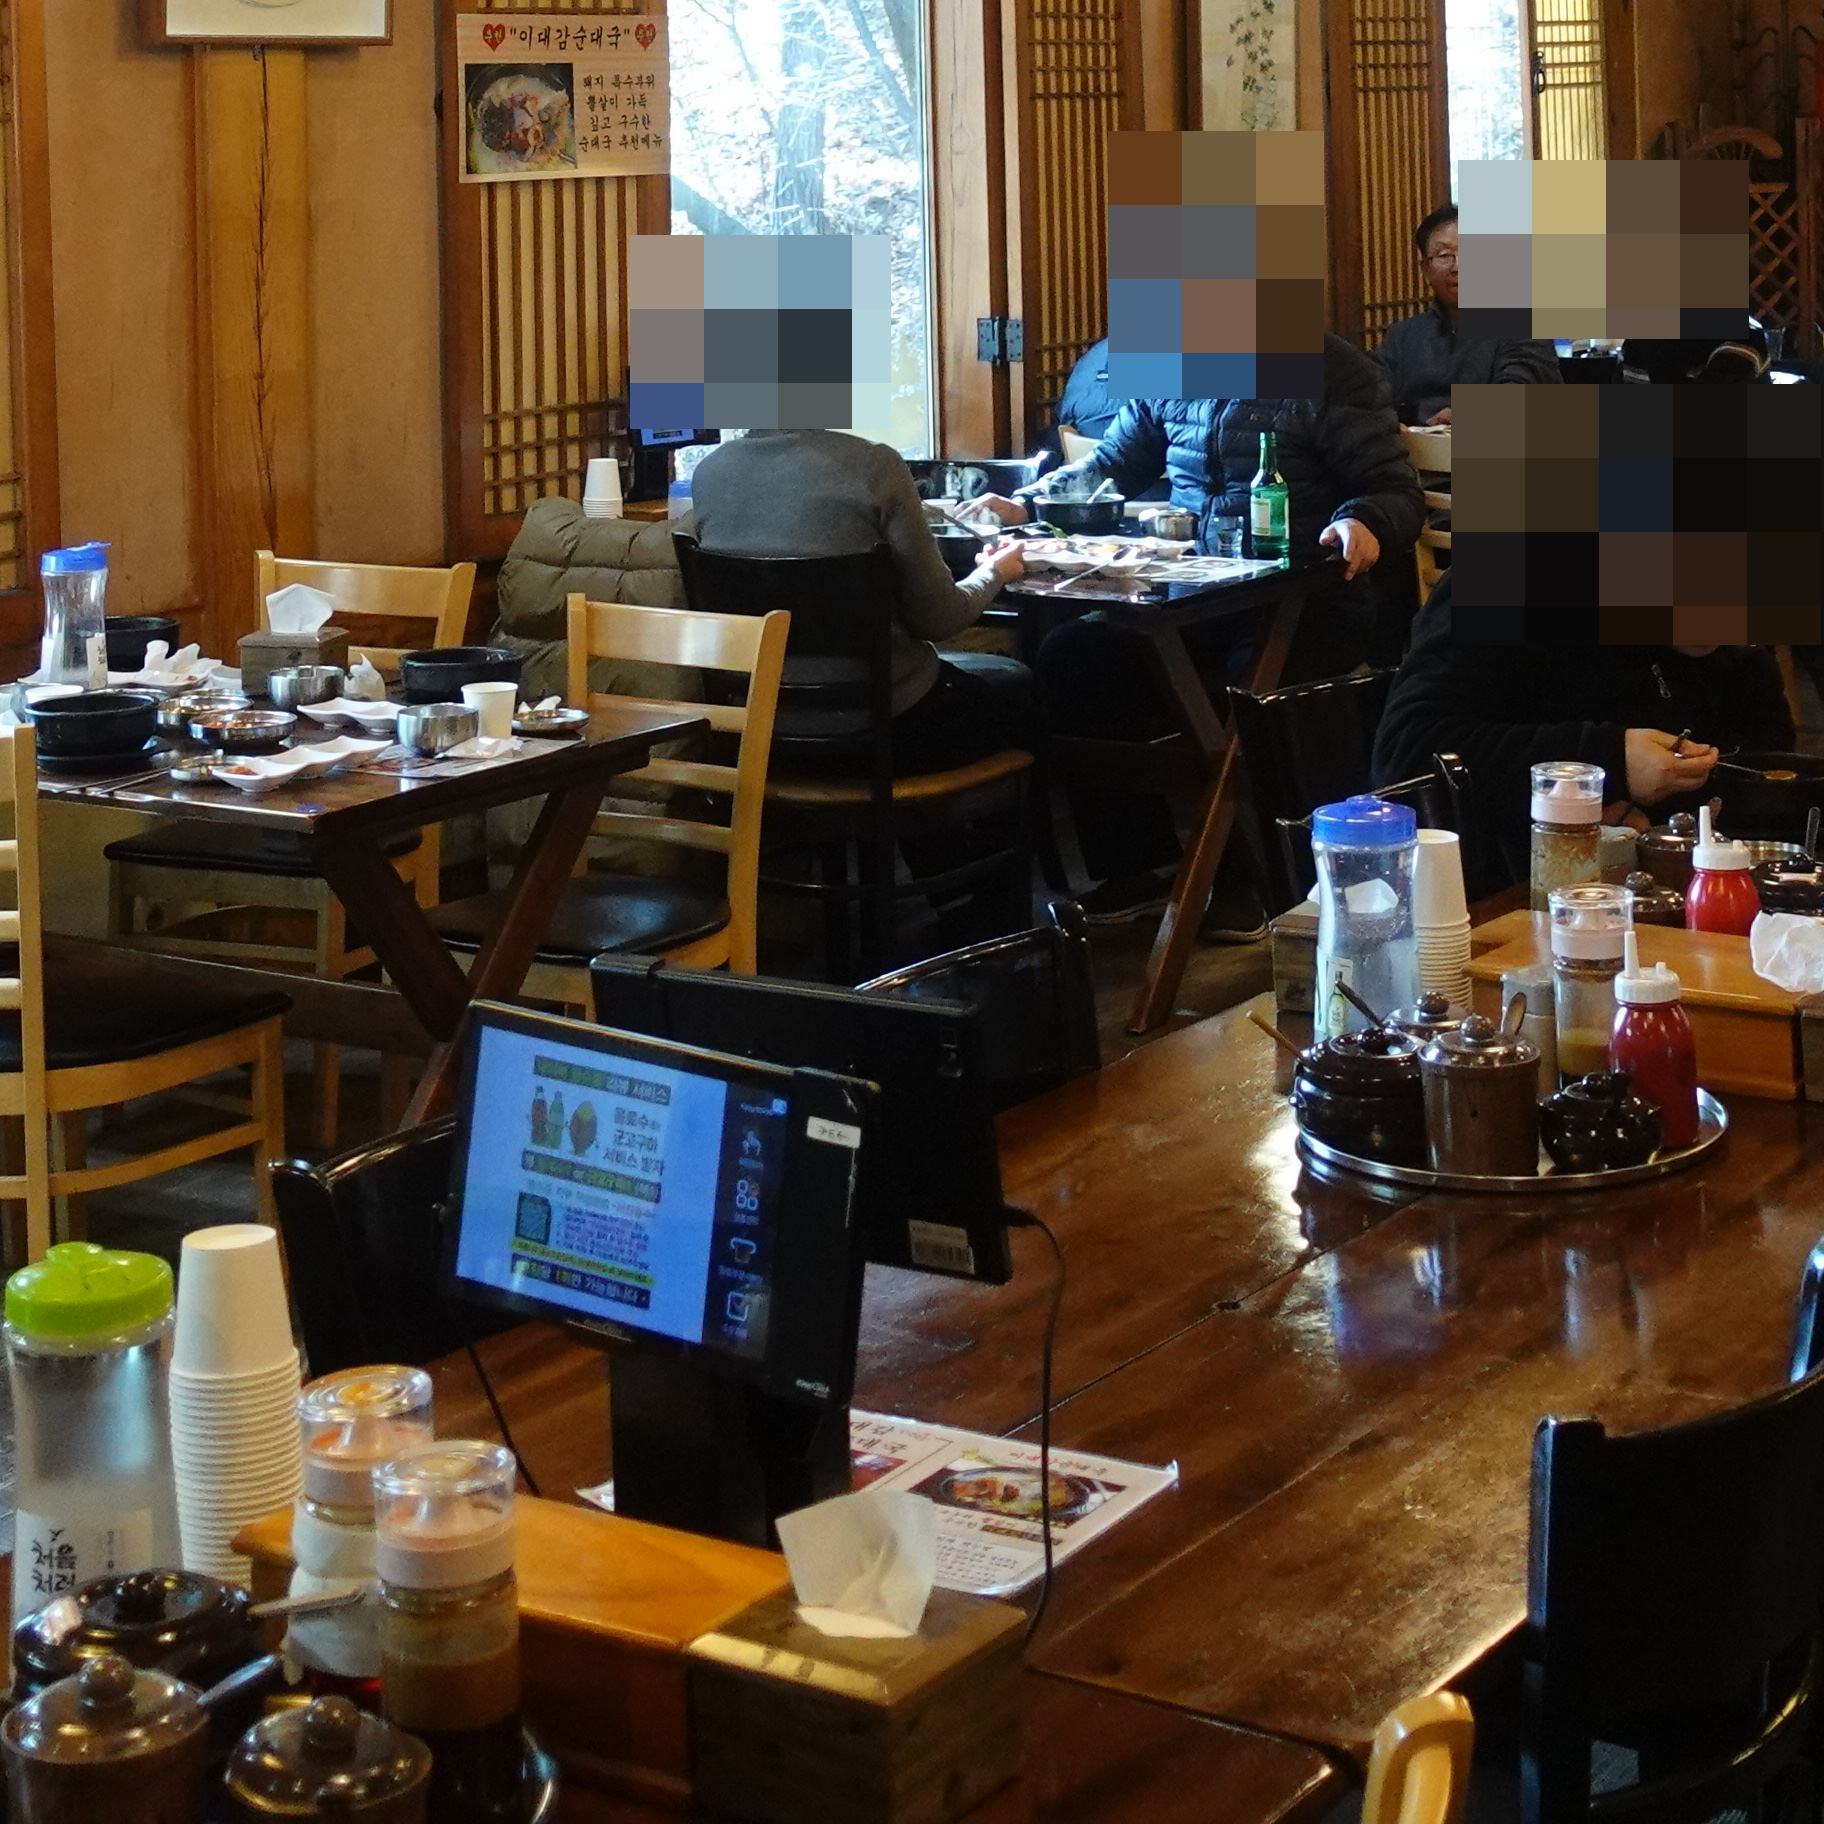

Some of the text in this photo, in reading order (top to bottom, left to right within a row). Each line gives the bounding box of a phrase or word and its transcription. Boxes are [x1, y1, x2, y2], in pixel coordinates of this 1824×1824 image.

[626, 93, 648, 110] 가득
[618, 113, 651, 130] 구수한
[579, 135, 612, 152] 순대국
[31, 1538, 77, 1569] 처음
